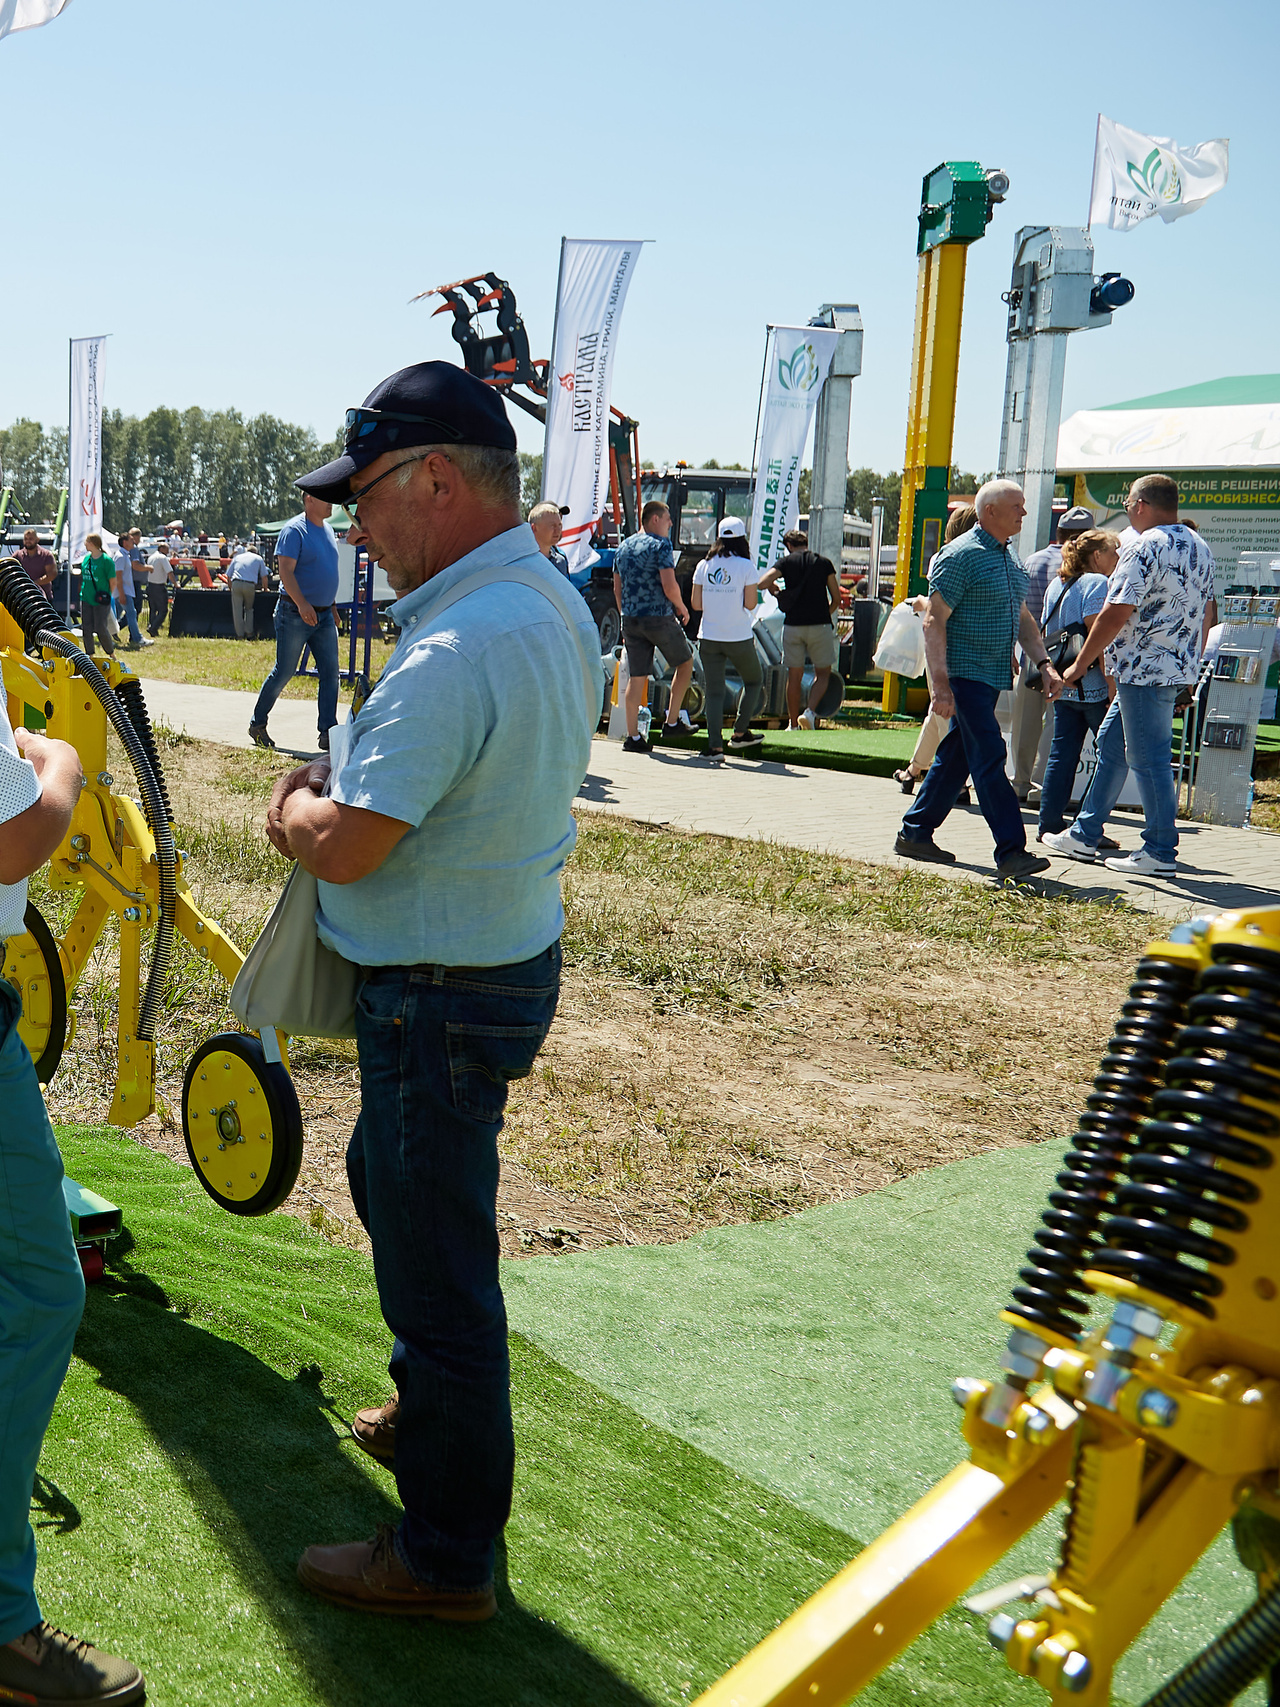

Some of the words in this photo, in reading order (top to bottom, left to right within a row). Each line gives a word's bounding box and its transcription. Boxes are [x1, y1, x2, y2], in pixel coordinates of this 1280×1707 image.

[610, 251, 631, 305] МАНГАЛЫ
[602, 308, 616, 348] ГРИЛИ,
[594, 436, 602, 466] ПЕЧИ
[592, 469, 600, 515] БАННЫЕ
[776, 455, 799, 561] ЕПАРАТОРЫ
[757, 498, 777, 570] TAIHO
